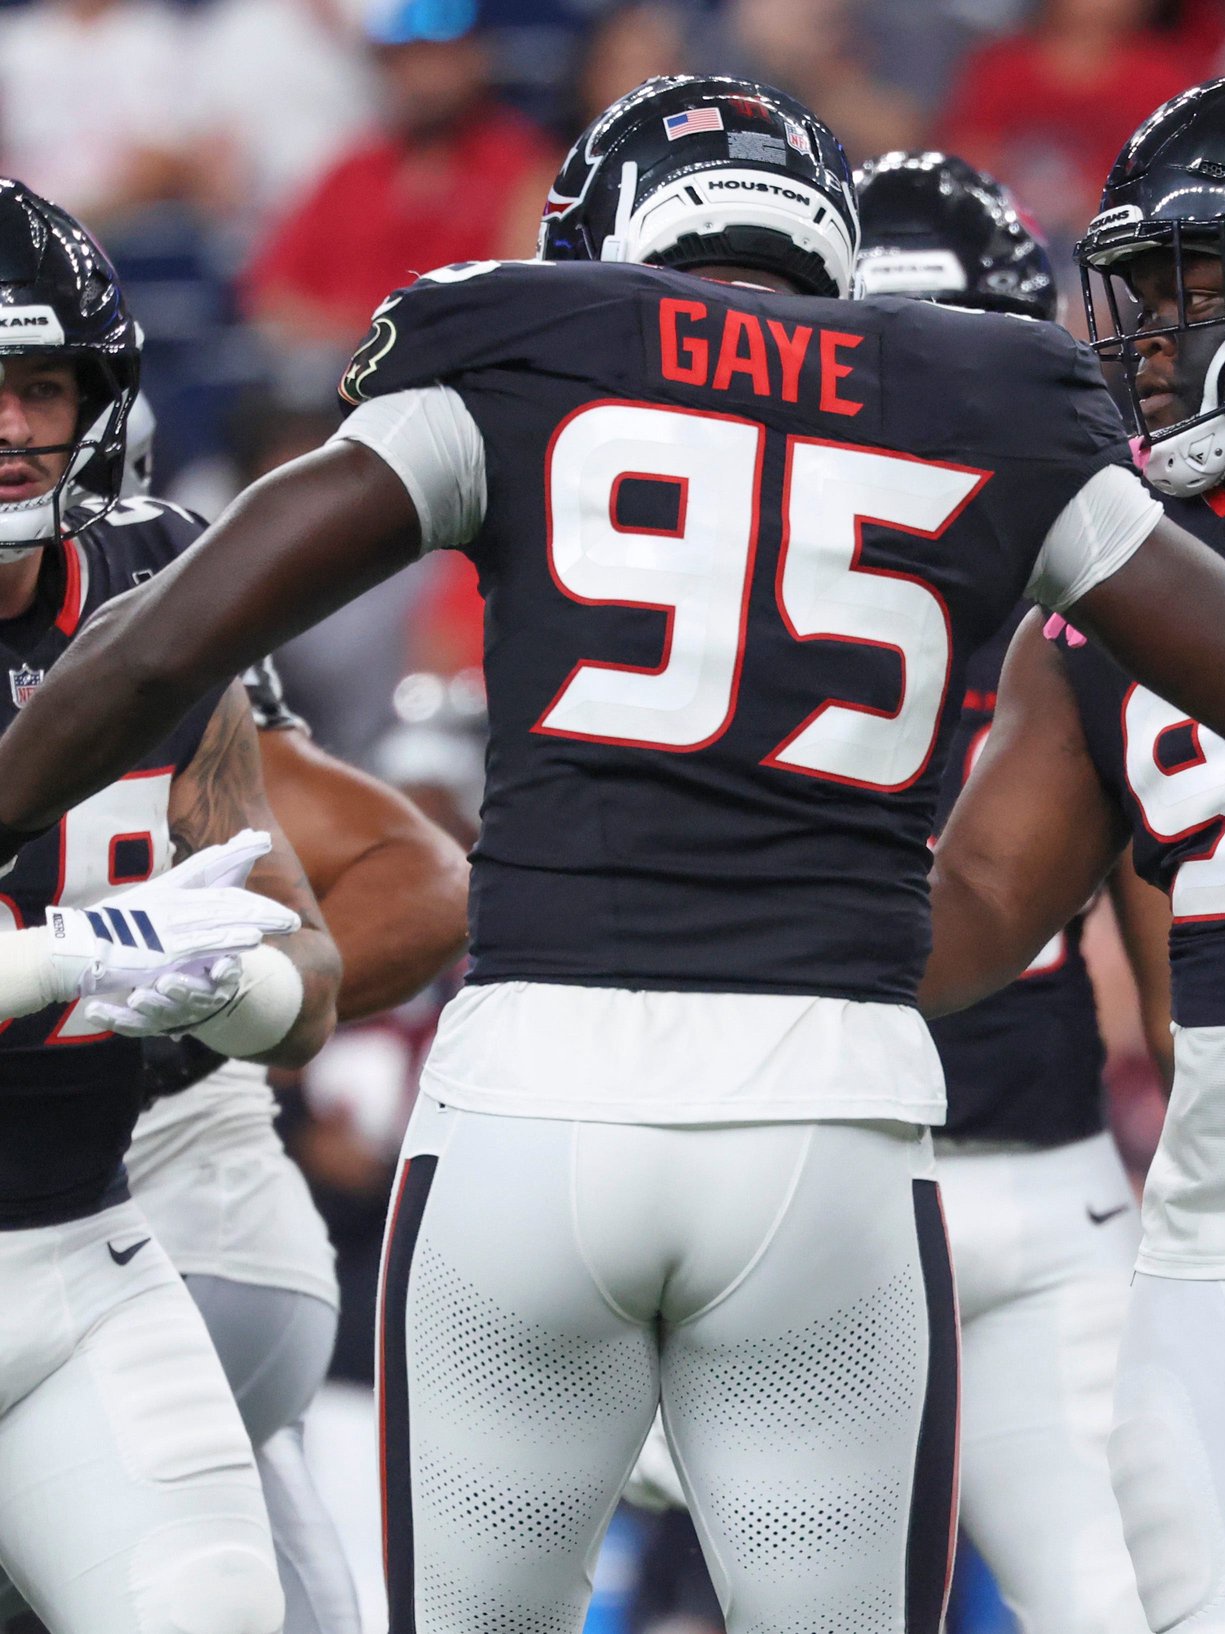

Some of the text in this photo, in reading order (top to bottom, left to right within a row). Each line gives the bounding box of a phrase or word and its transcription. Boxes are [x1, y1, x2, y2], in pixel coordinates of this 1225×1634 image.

[708, 179, 811, 206] HOUSTON
[658, 297, 864, 417] GAYE
[528, 397, 996, 793] 95
